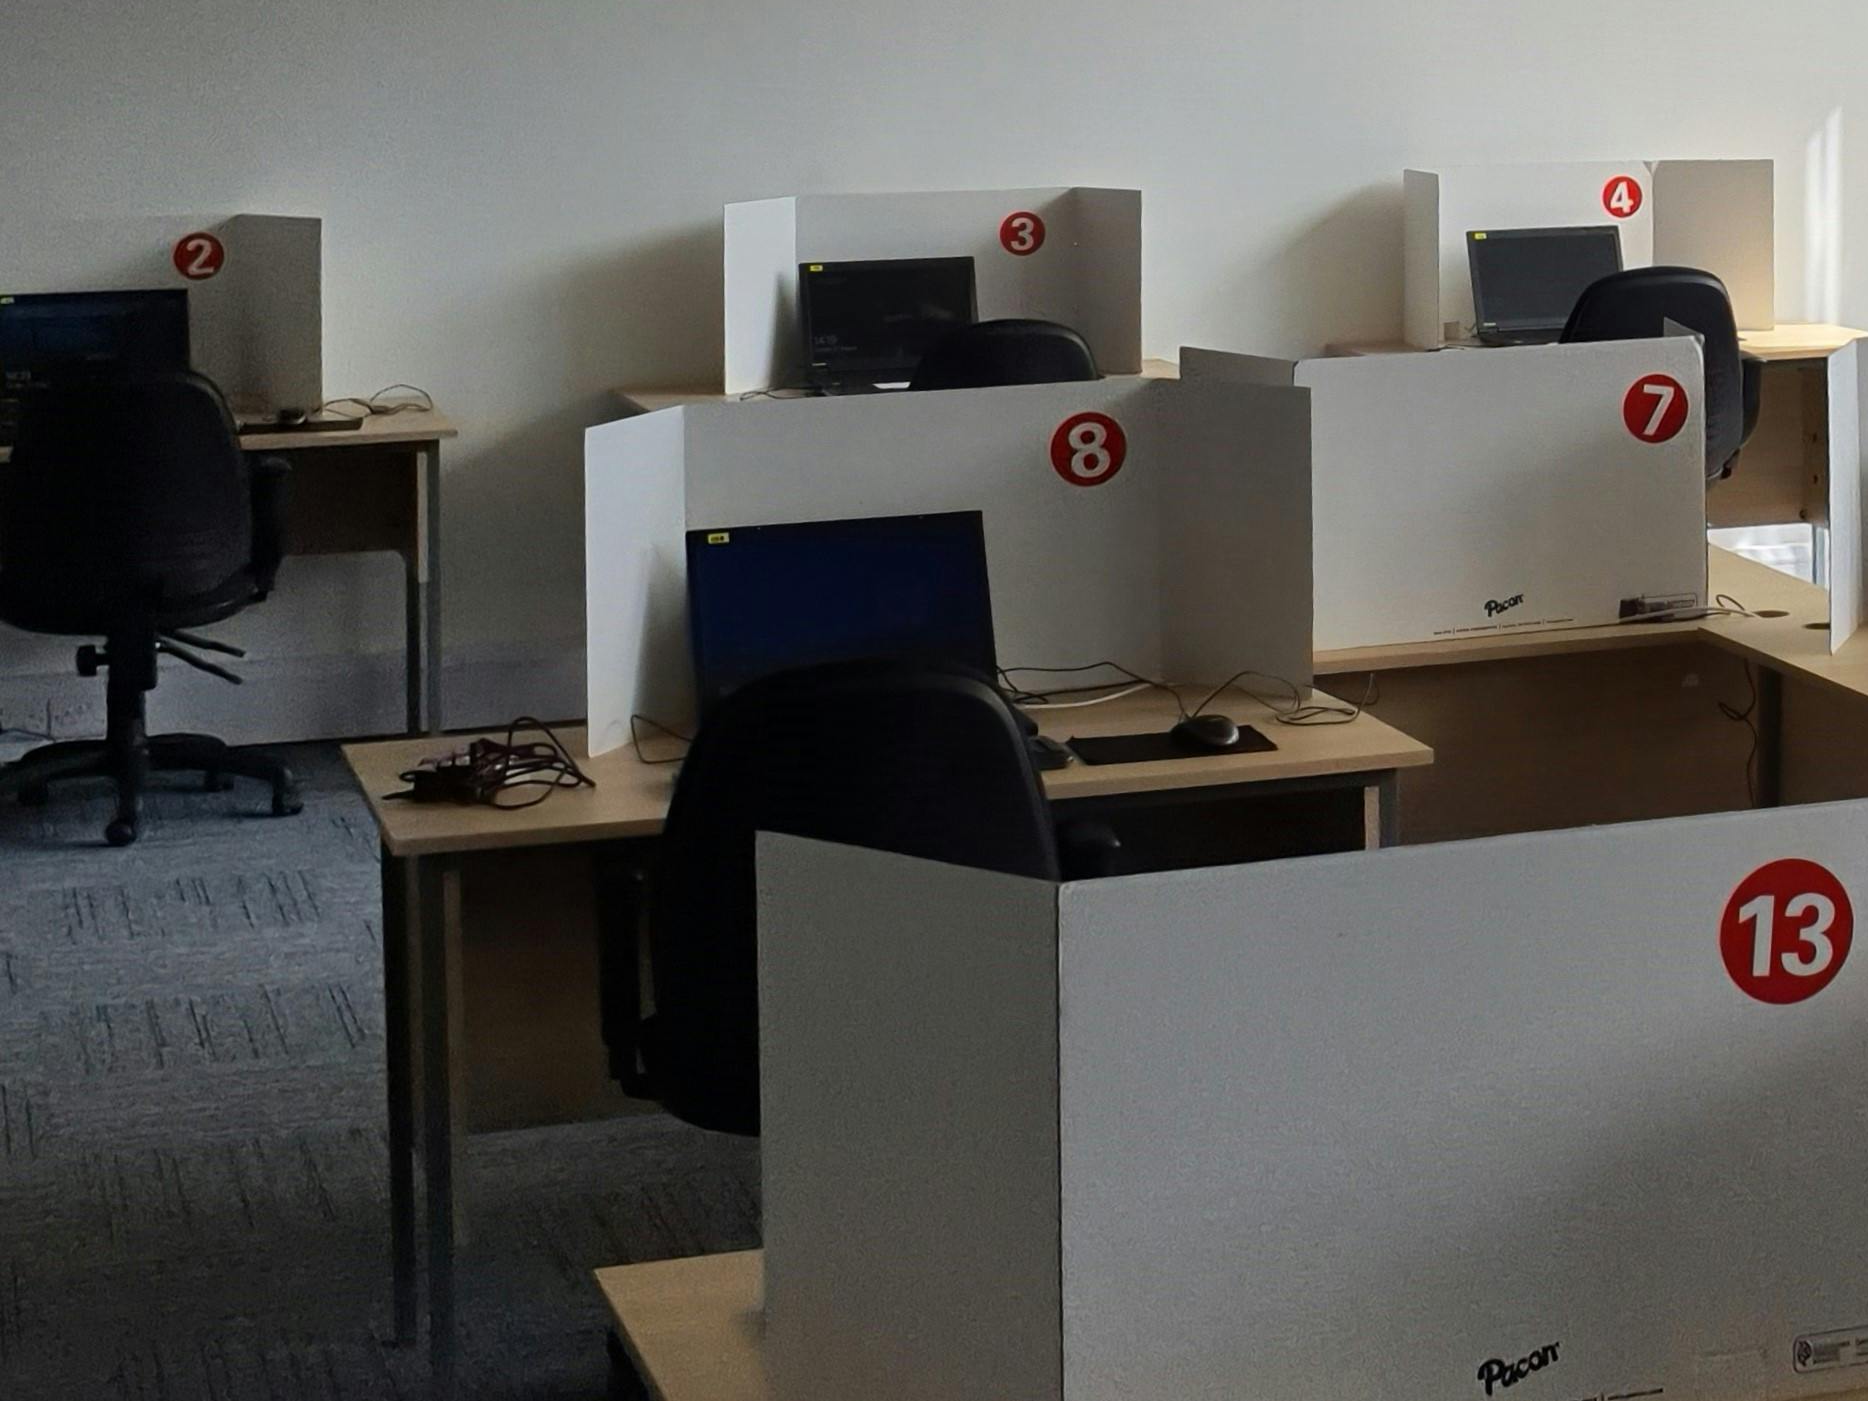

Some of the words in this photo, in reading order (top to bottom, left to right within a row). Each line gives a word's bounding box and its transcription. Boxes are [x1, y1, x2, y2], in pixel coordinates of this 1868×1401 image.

[1611, 181, 1633, 213] 4
[1011, 216, 1035, 251] 3
[186, 238, 214, 276] 2
[1642, 383, 1674, 436] 7
[1067, 421, 1110, 478] 8
[1483, 593, 1524, 618] Pacon
[1738, 891, 1836, 978] 13
[1476, 1341, 1561, 1397] Pacon
